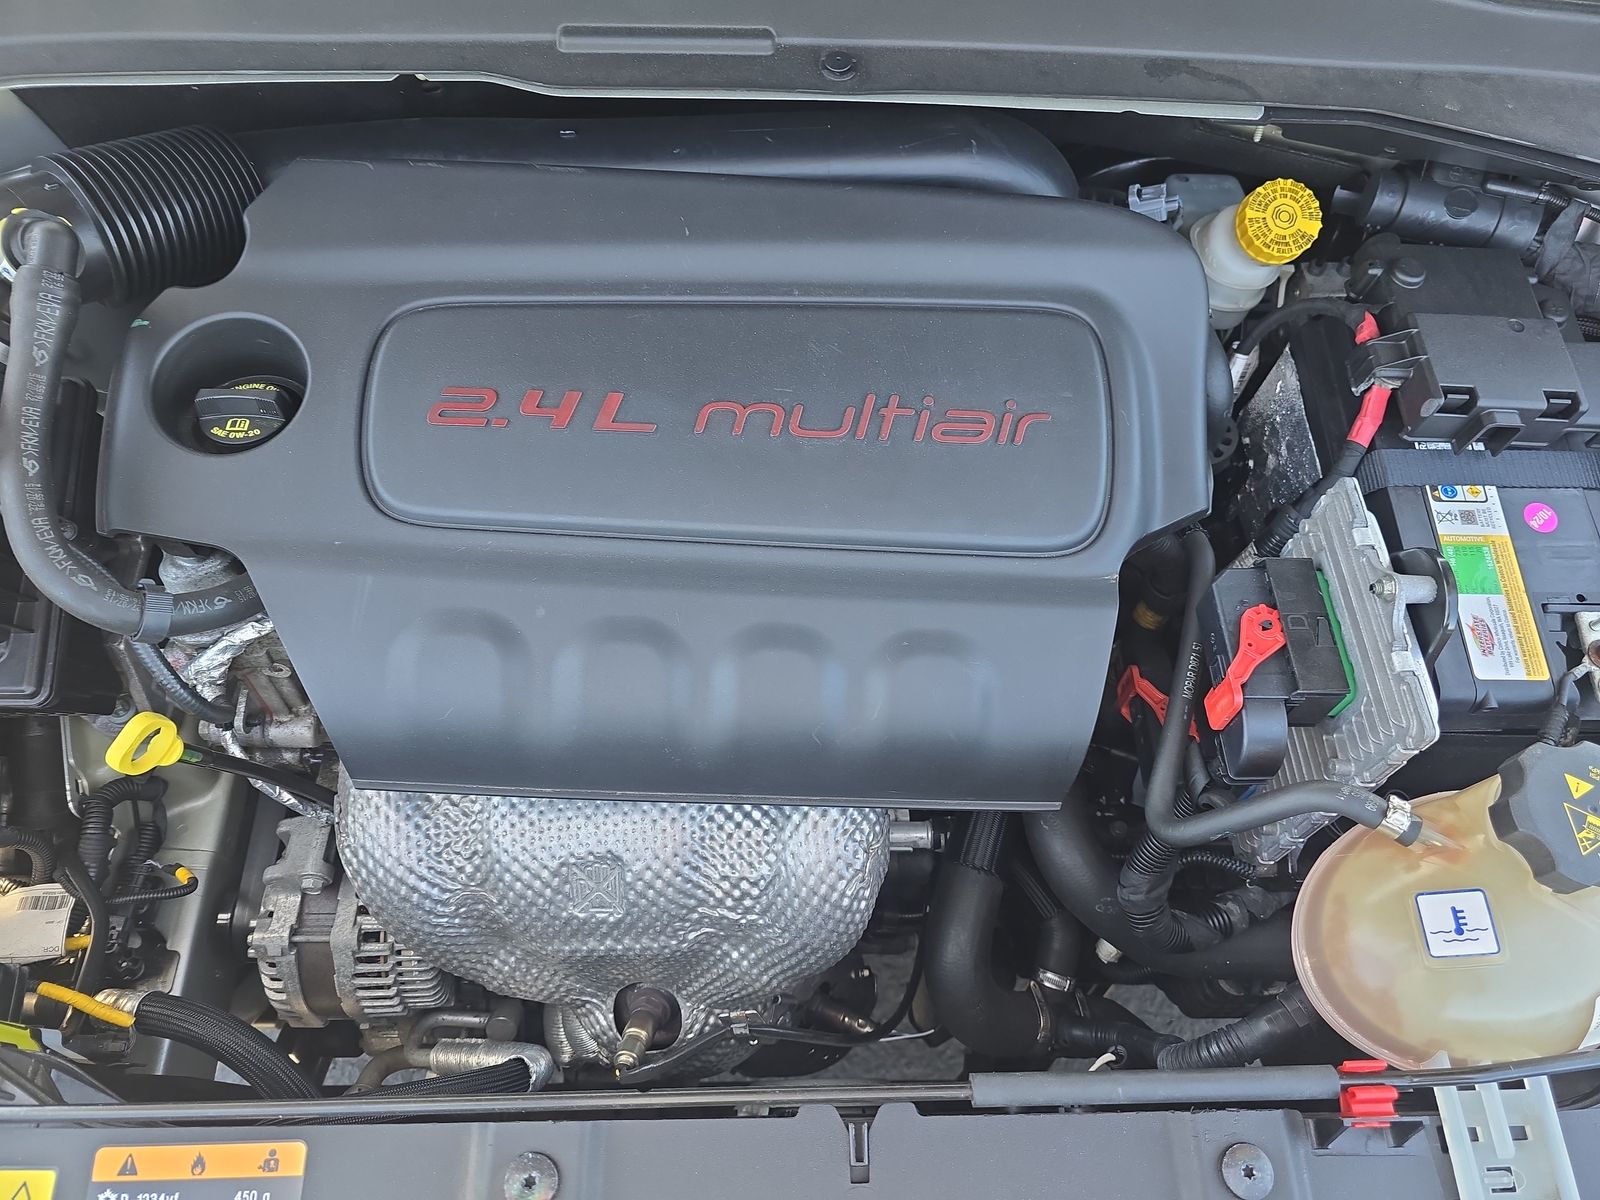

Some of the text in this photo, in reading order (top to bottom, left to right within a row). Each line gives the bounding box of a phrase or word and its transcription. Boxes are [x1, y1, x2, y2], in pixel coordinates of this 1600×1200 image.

[694, 393, 1052, 446] multiair
[210, 426, 229, 438] SAE
[1529, 507, 1552, 530] 10/24
[1488, 540, 1501, 564] Wholesale
[1496, 565, 1506, 581] Costco
[1502, 589, 1514, 611] batteries
[1471, 615, 1488, 656] INTERSTATE
[1478, 618, 1494, 655] BATTERIES
[1516, 636, 1529, 657] warranty
[1522, 658, 1532, 675] Return
[1182, 671, 1197, 700] MOPAR
